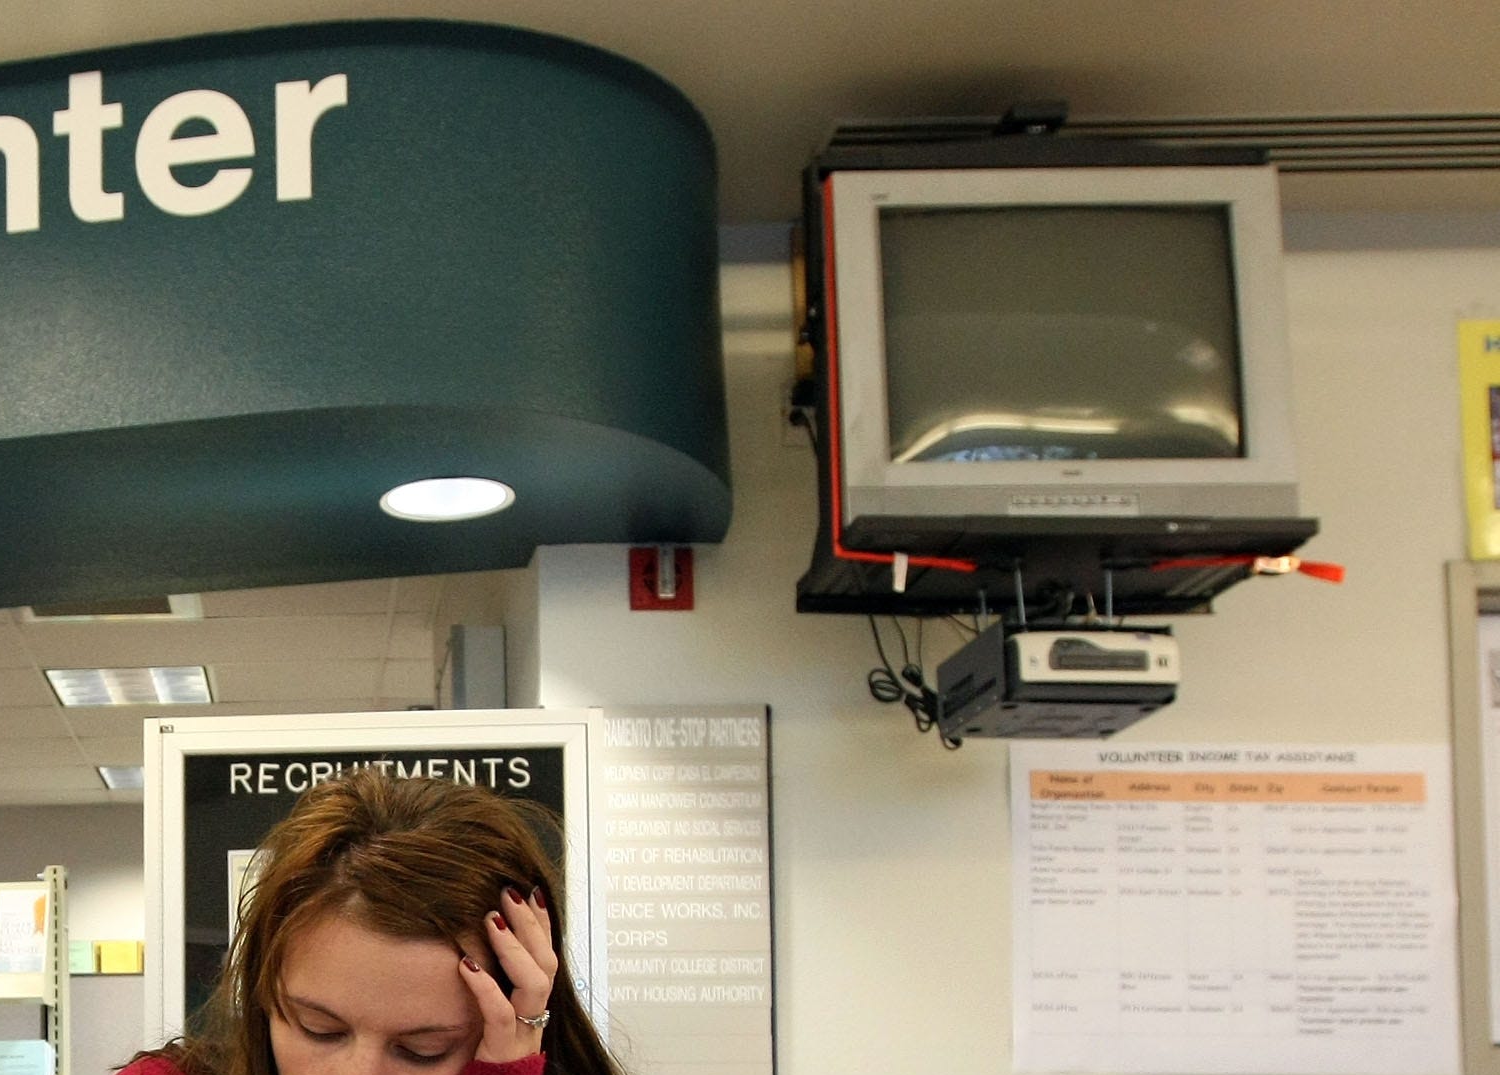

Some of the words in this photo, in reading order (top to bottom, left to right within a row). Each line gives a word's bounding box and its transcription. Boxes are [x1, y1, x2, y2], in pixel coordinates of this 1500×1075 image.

[655, 717, 707, 748] ONE-STOP
[708, 717, 761, 748] PARTNERS
[1098, 750, 1184, 764] VOLUNTEER
[1187, 750, 1238, 763] INCOME
[1246, 750, 1270, 763] TAX
[1276, 750, 1358, 763] ASSISTANCE
[1050, 775, 1079, 784] Name
[1082, 775, 1094, 784] of
[1039, 789, 1105, 800] Organization
[1128, 783, 1171, 792] Address
[1194, 783, 1215, 794] City
[1266, 783, 1285, 794] Zip
[1320, 783, 1363, 793] Contact
[642, 791, 696, 809] MANPOWER
[699, 791, 762, 809] CONSORTIUM
[620, 820, 671, 836] EMPLOYMENT
[674, 820, 690, 836] AND
[692, 820, 721, 836] SOCIAL
[723, 820, 762, 836] SERVICES
[642, 847, 660, 864] OF
[664, 847, 763, 864] REHABILITATION
[624, 874, 694, 892] DEVELOPMENT
[698, 874, 763, 892] DEPARTMENT
[733, 902, 764, 920] INC.
[670, 957, 717, 975] COLLEGE
[720, 957, 765, 975] DISTRICT
[644, 985, 696, 1002] HOUSING
[700, 985, 765, 1002] AUTHORITY
